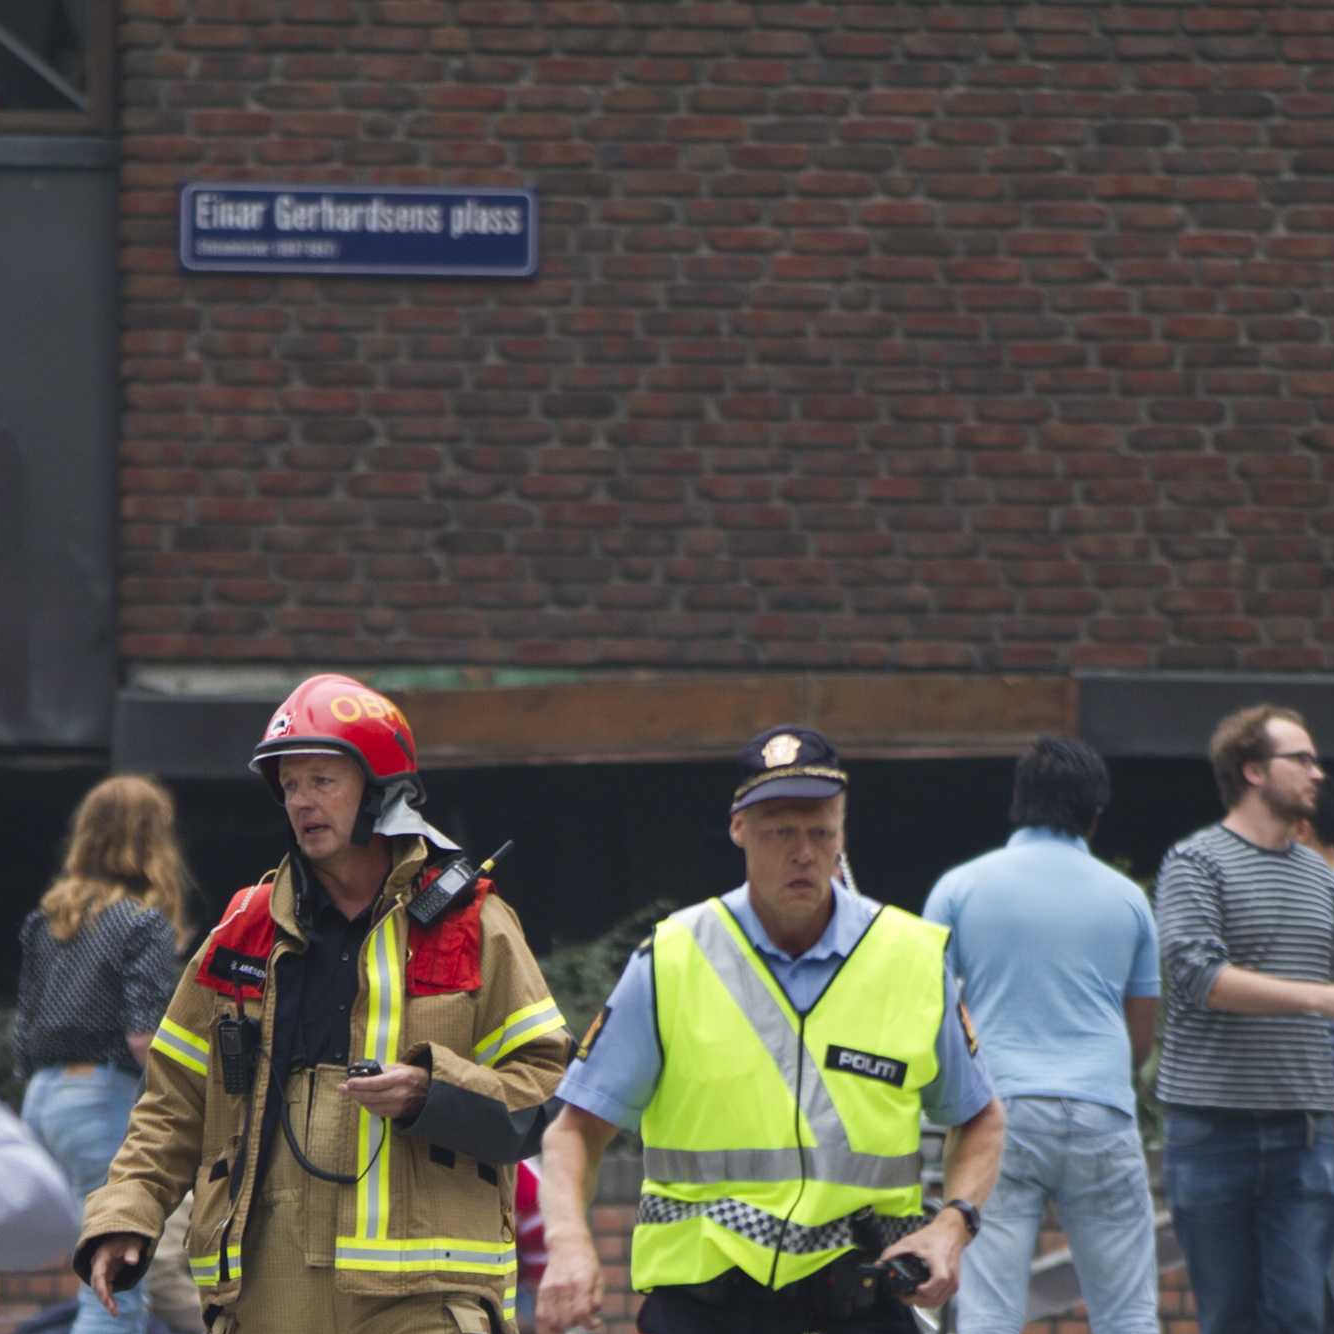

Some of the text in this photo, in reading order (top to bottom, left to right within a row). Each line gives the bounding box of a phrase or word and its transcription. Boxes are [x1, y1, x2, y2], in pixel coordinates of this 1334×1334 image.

[195, 194, 524, 240] Einar Gerhardsens plass
[330, 694, 410, 729] OBR
[838, 1050, 897, 1080] POLITI
